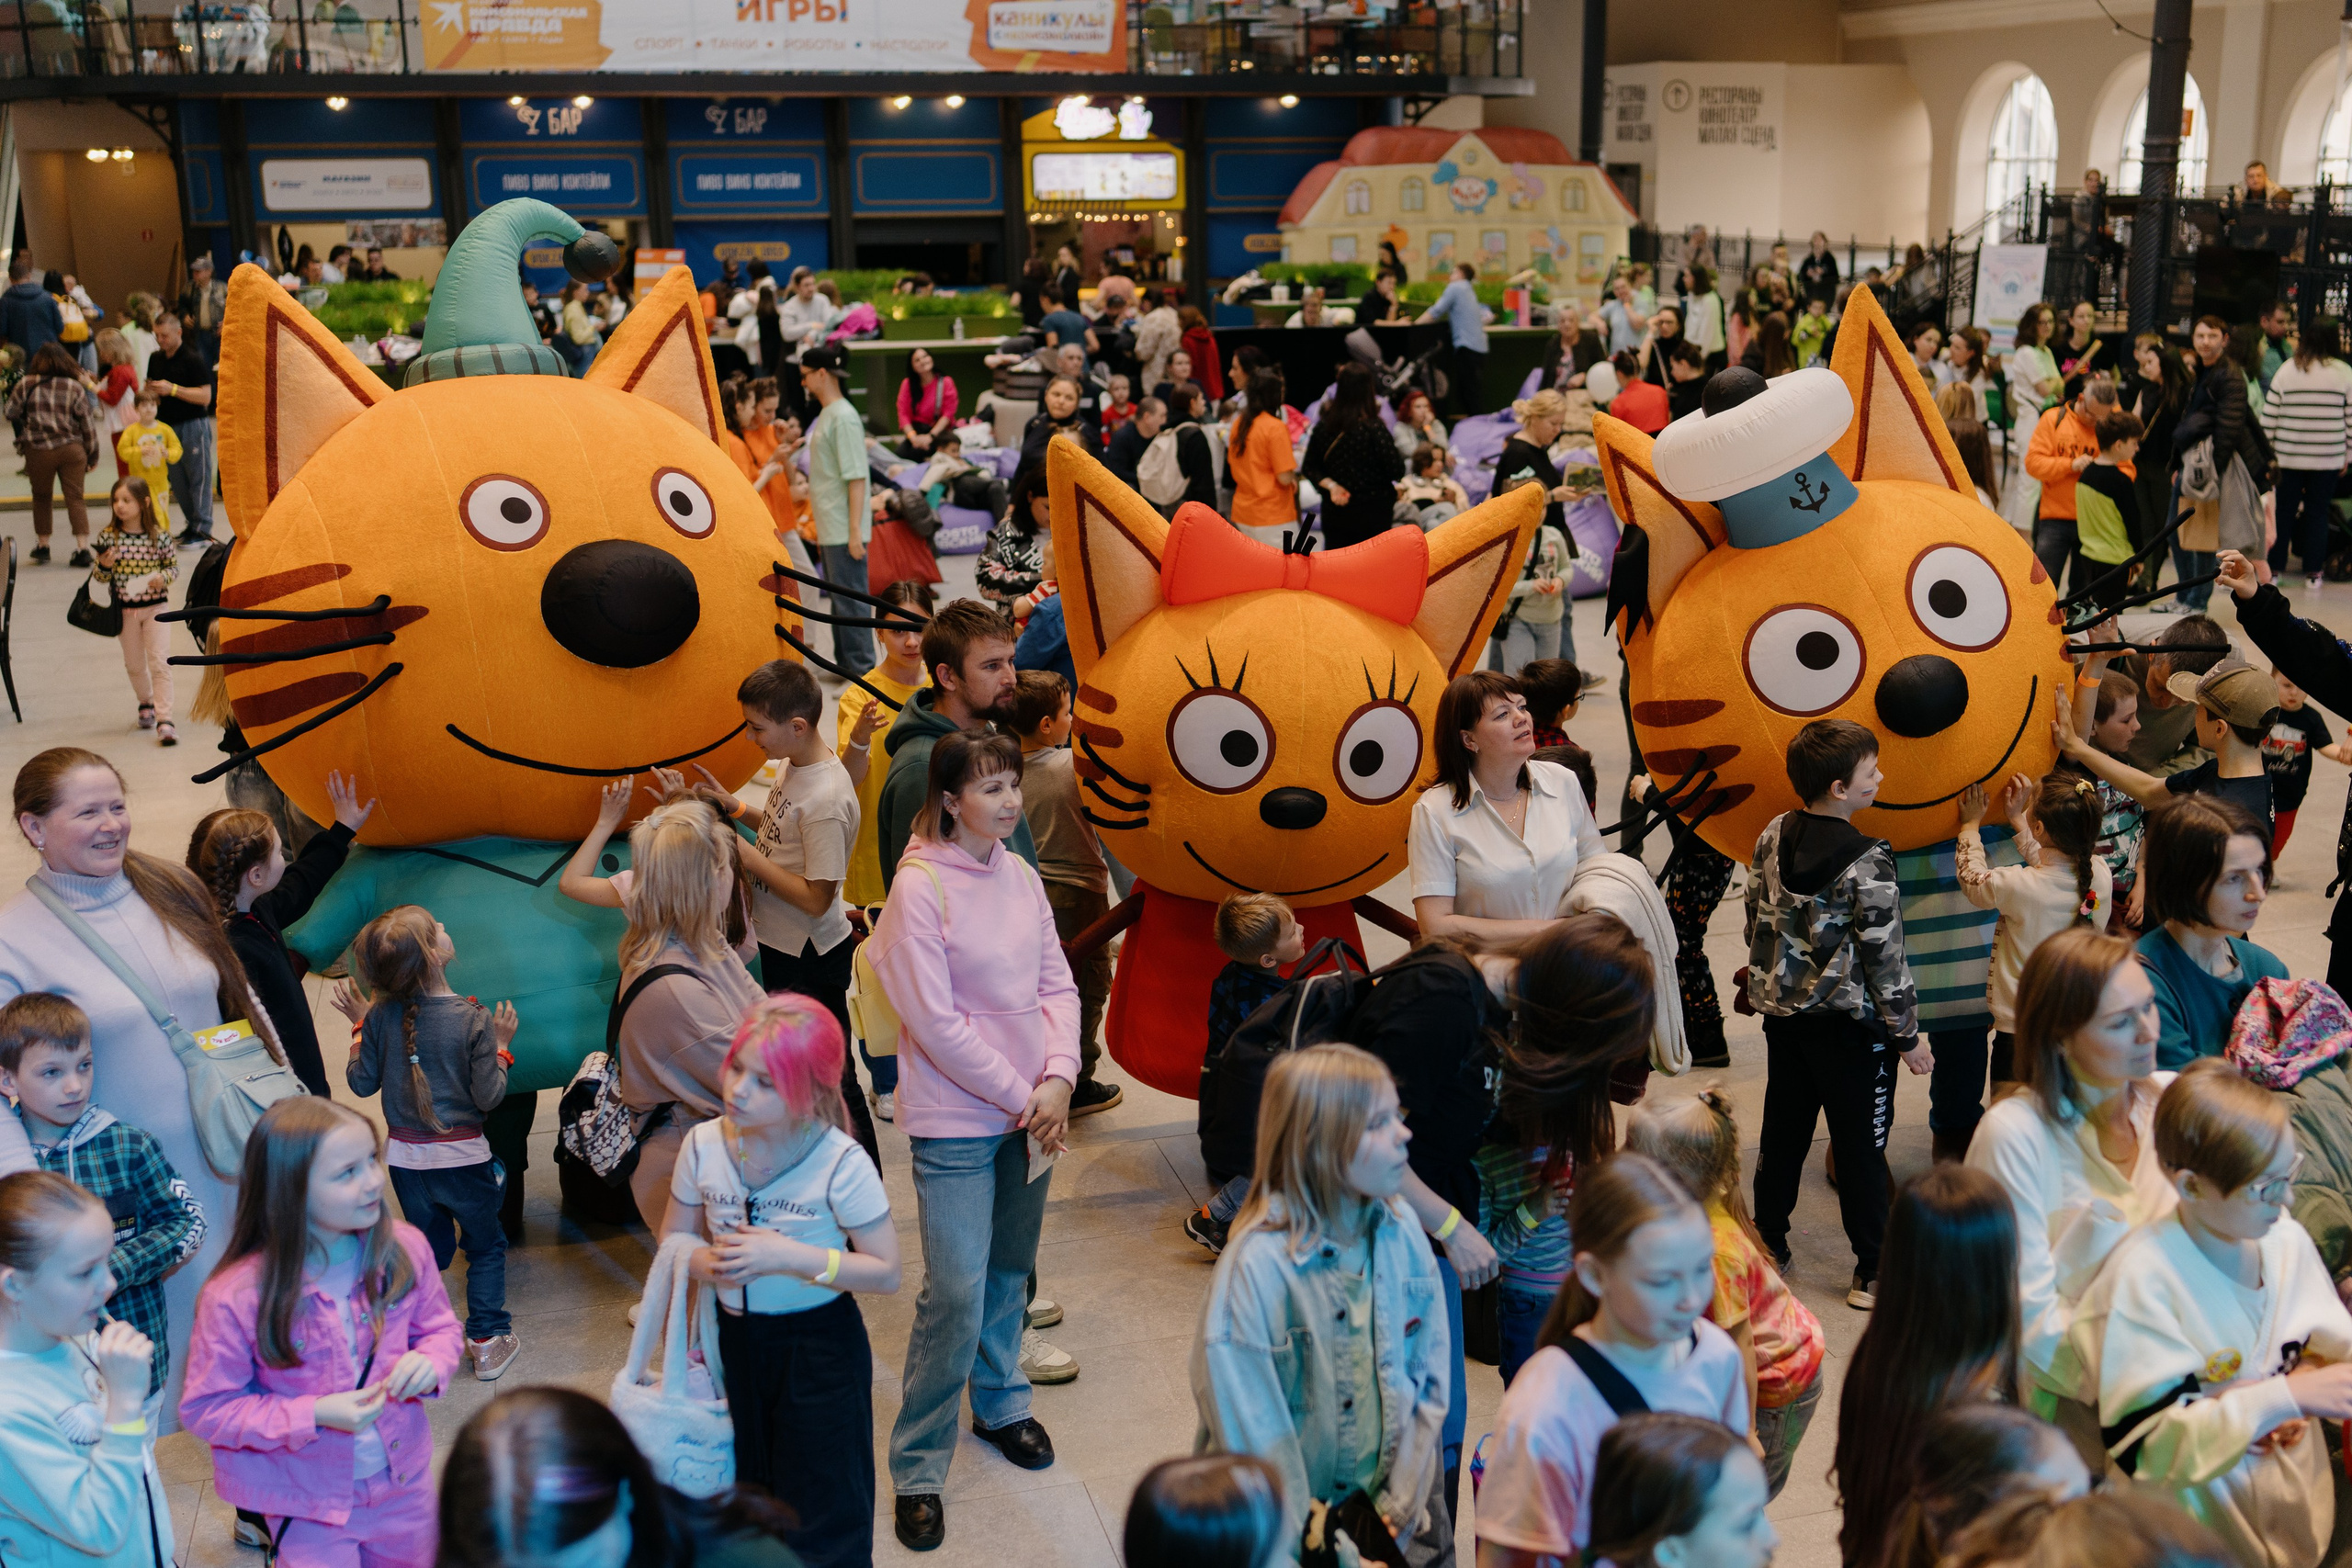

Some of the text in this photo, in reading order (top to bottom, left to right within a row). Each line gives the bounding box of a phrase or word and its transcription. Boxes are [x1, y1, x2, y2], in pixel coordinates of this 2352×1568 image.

[736, 0, 849, 22] ИГРЫ
[469, 18, 563, 35] ПРАВДА
[548, 107, 583, 135] БАР
[735, 107, 767, 134] БАР
[1872, 1086, 1888, 1148] JORDAN
